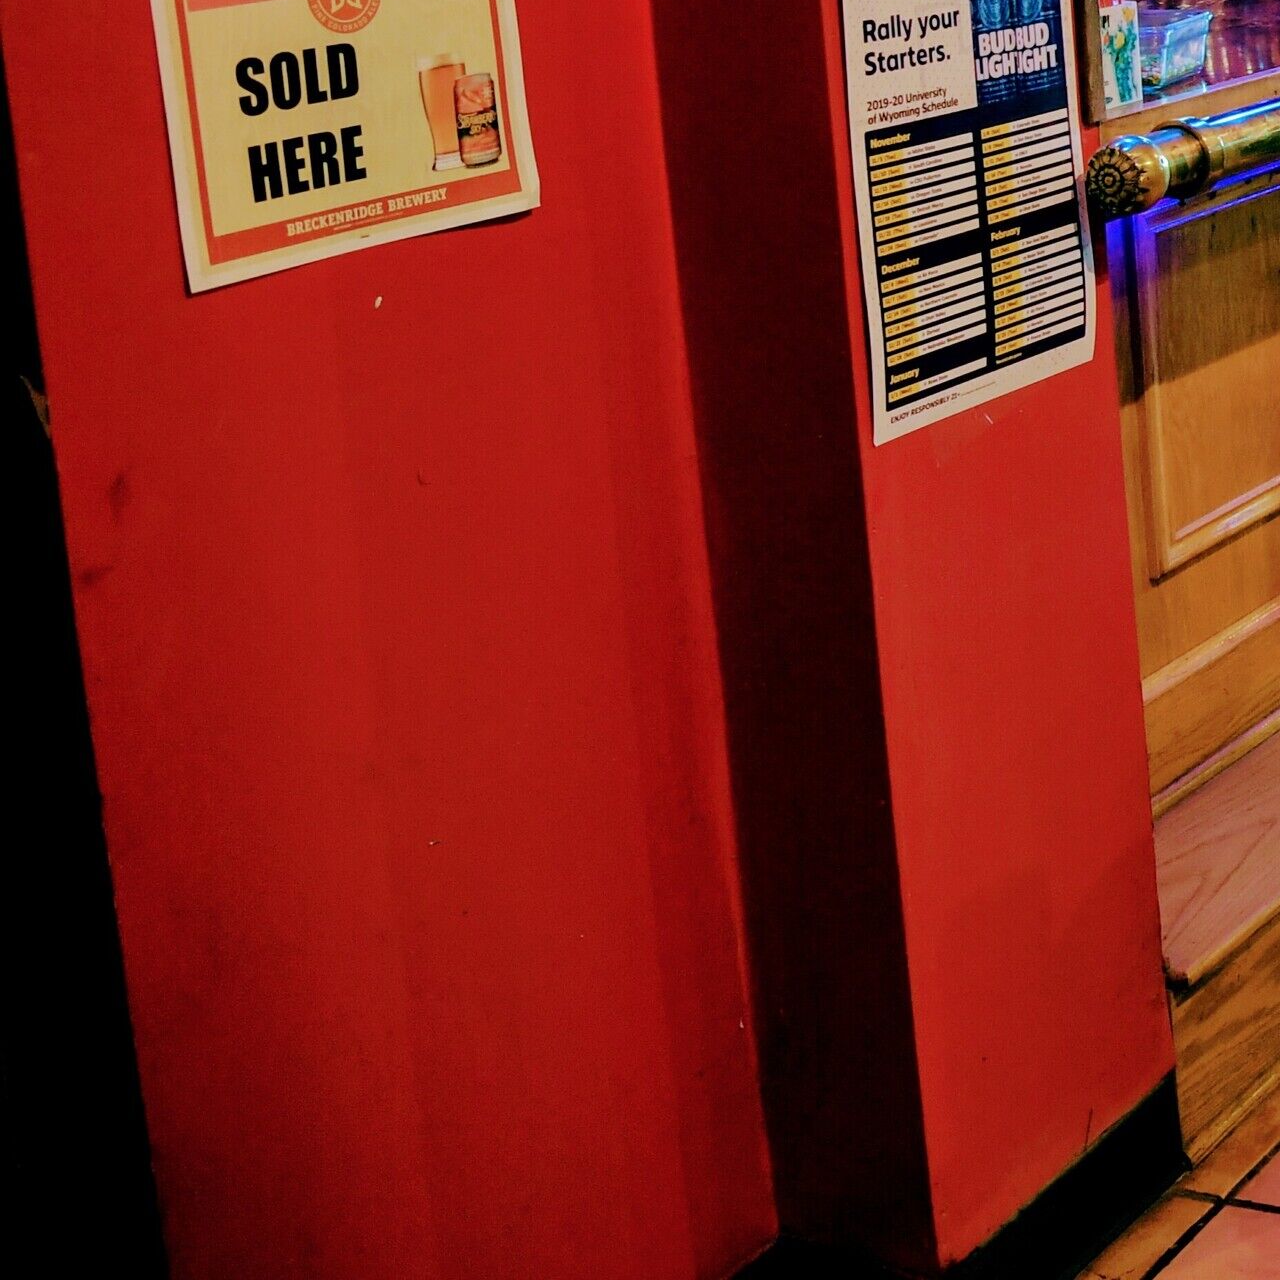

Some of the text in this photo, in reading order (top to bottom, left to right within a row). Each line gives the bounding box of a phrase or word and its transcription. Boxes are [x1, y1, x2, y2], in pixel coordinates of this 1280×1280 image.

[862, 10, 960, 44] Rally your
[977, 28, 1016, 58] BUD
[864, 43, 952, 76] Starters.
[234, 42, 360, 117] SOLD
[866, 86, 947, 112] 2019-20 University
[867, 97, 959, 125] of Wyoming Schedule
[870, 132, 911, 149] November
[247, 124, 367, 204] HERE
[286, 201, 384, 237] BRECKENRIDGE
[388, 187, 448, 213] BREWERY
[990, 226, 1022, 242] February
[881, 257, 920, 276] December
[889, 367, 920, 386] January
[890, 411, 910, 425] ENJOY
[910, 395, 951, 416] RESPONSIBLY
